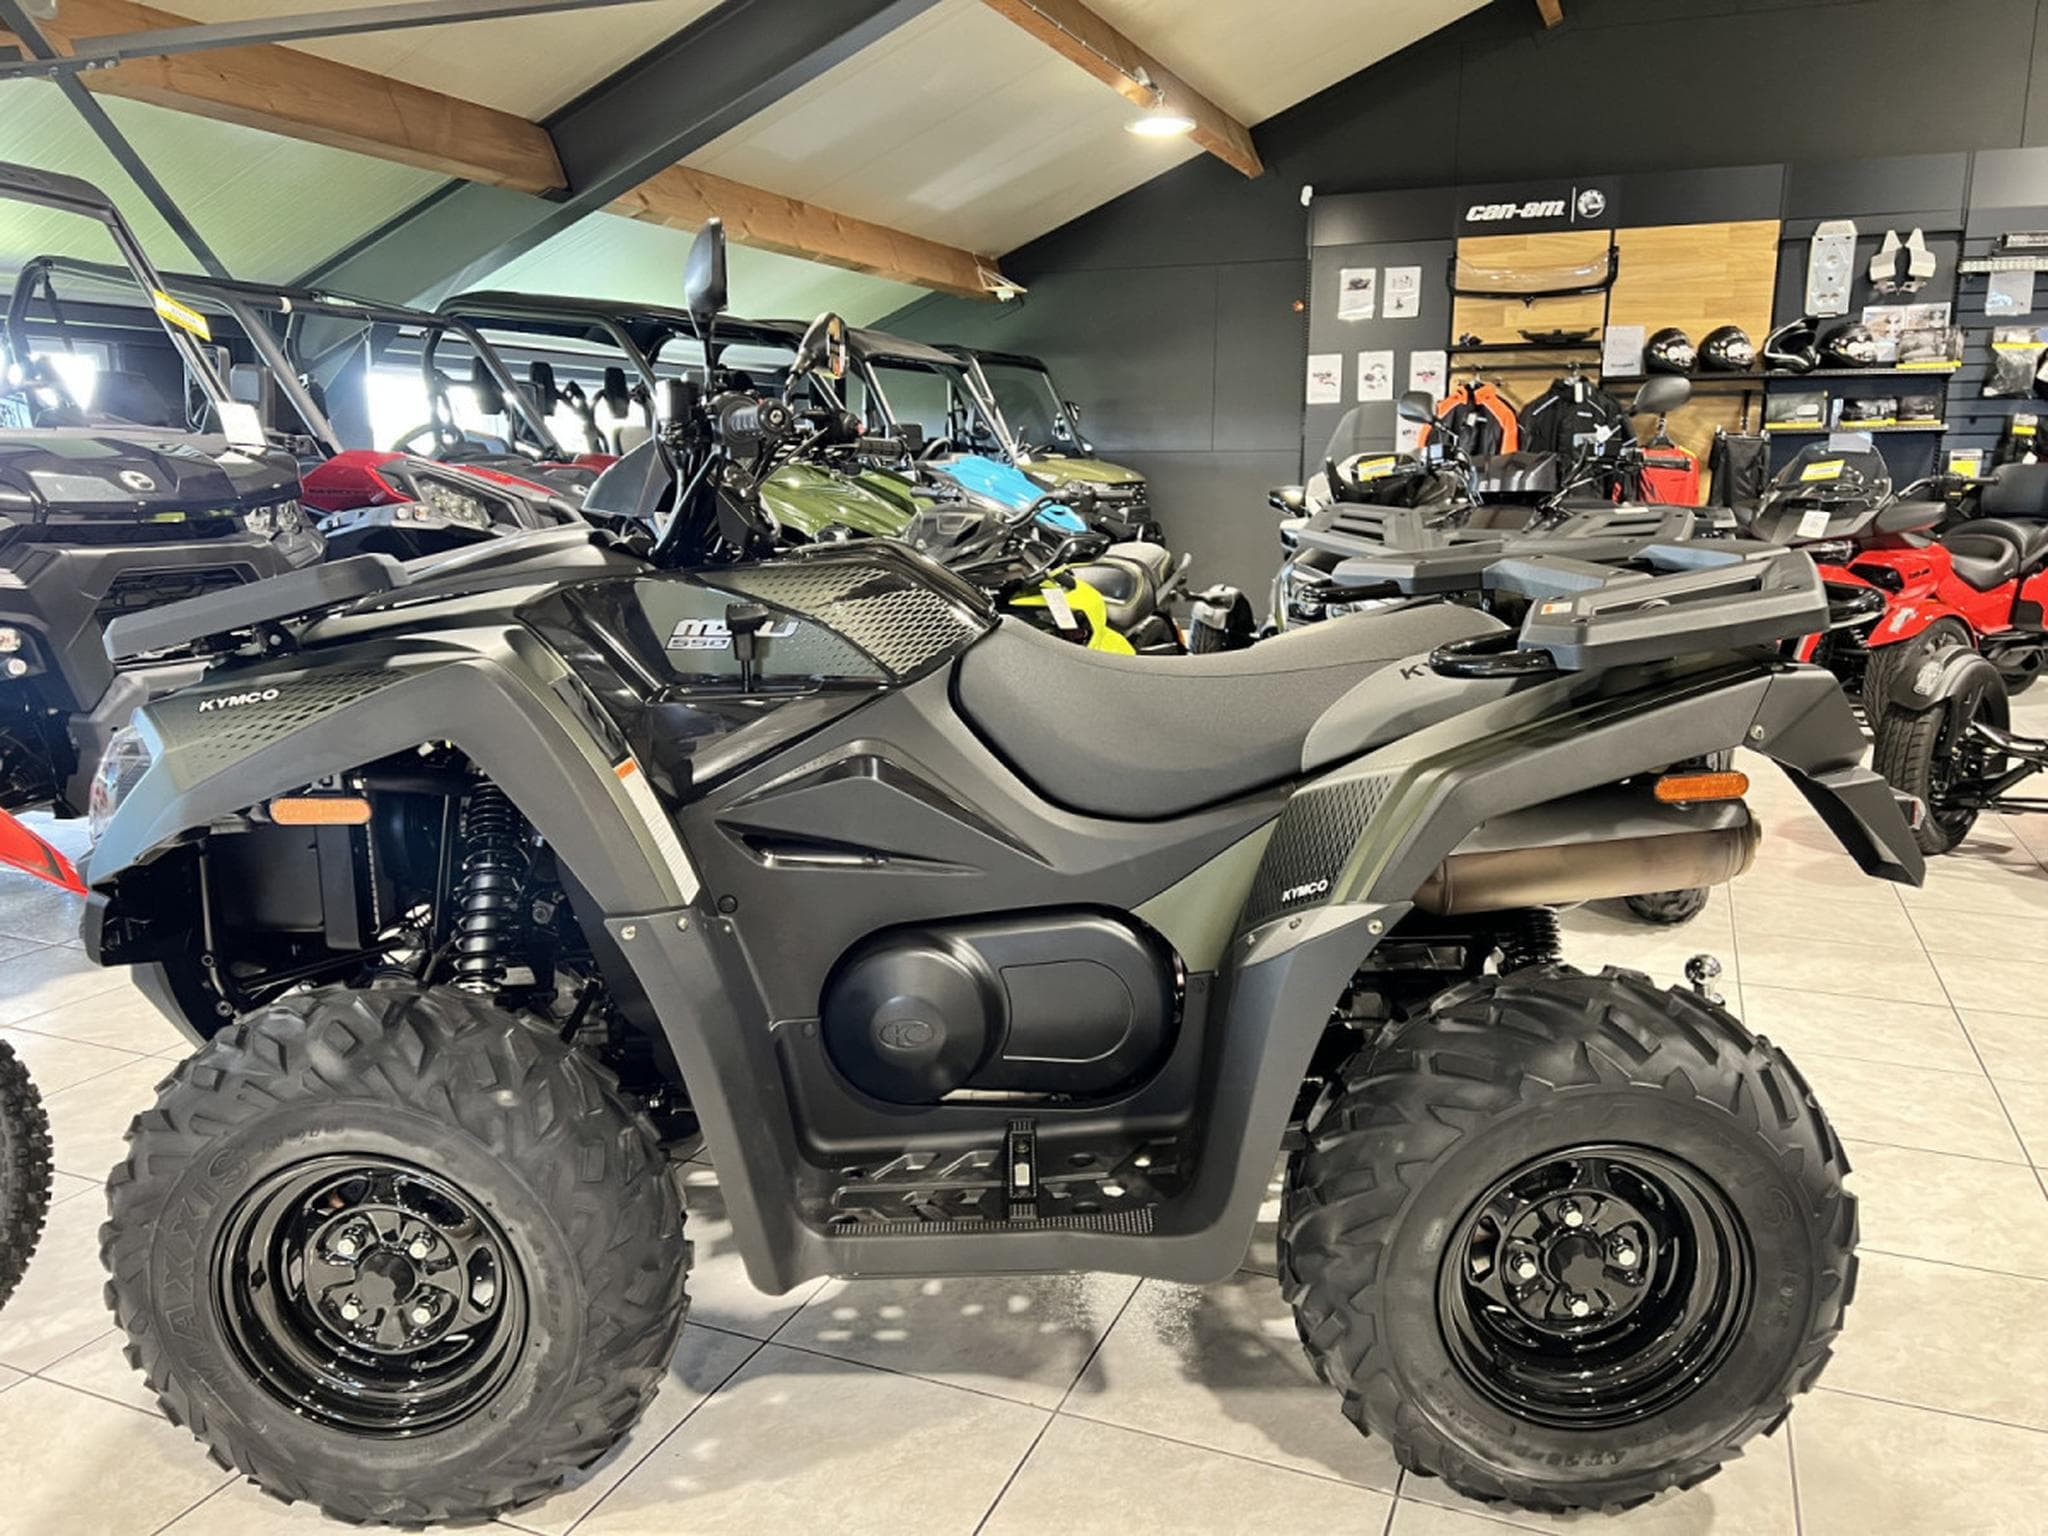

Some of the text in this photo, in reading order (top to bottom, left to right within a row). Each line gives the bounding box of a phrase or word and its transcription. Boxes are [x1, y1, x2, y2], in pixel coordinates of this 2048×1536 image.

[1465, 201, 1565, 221] can-am
[199, 689, 279, 712] KYMCO
[1282, 879, 1328, 902] KYMCO
